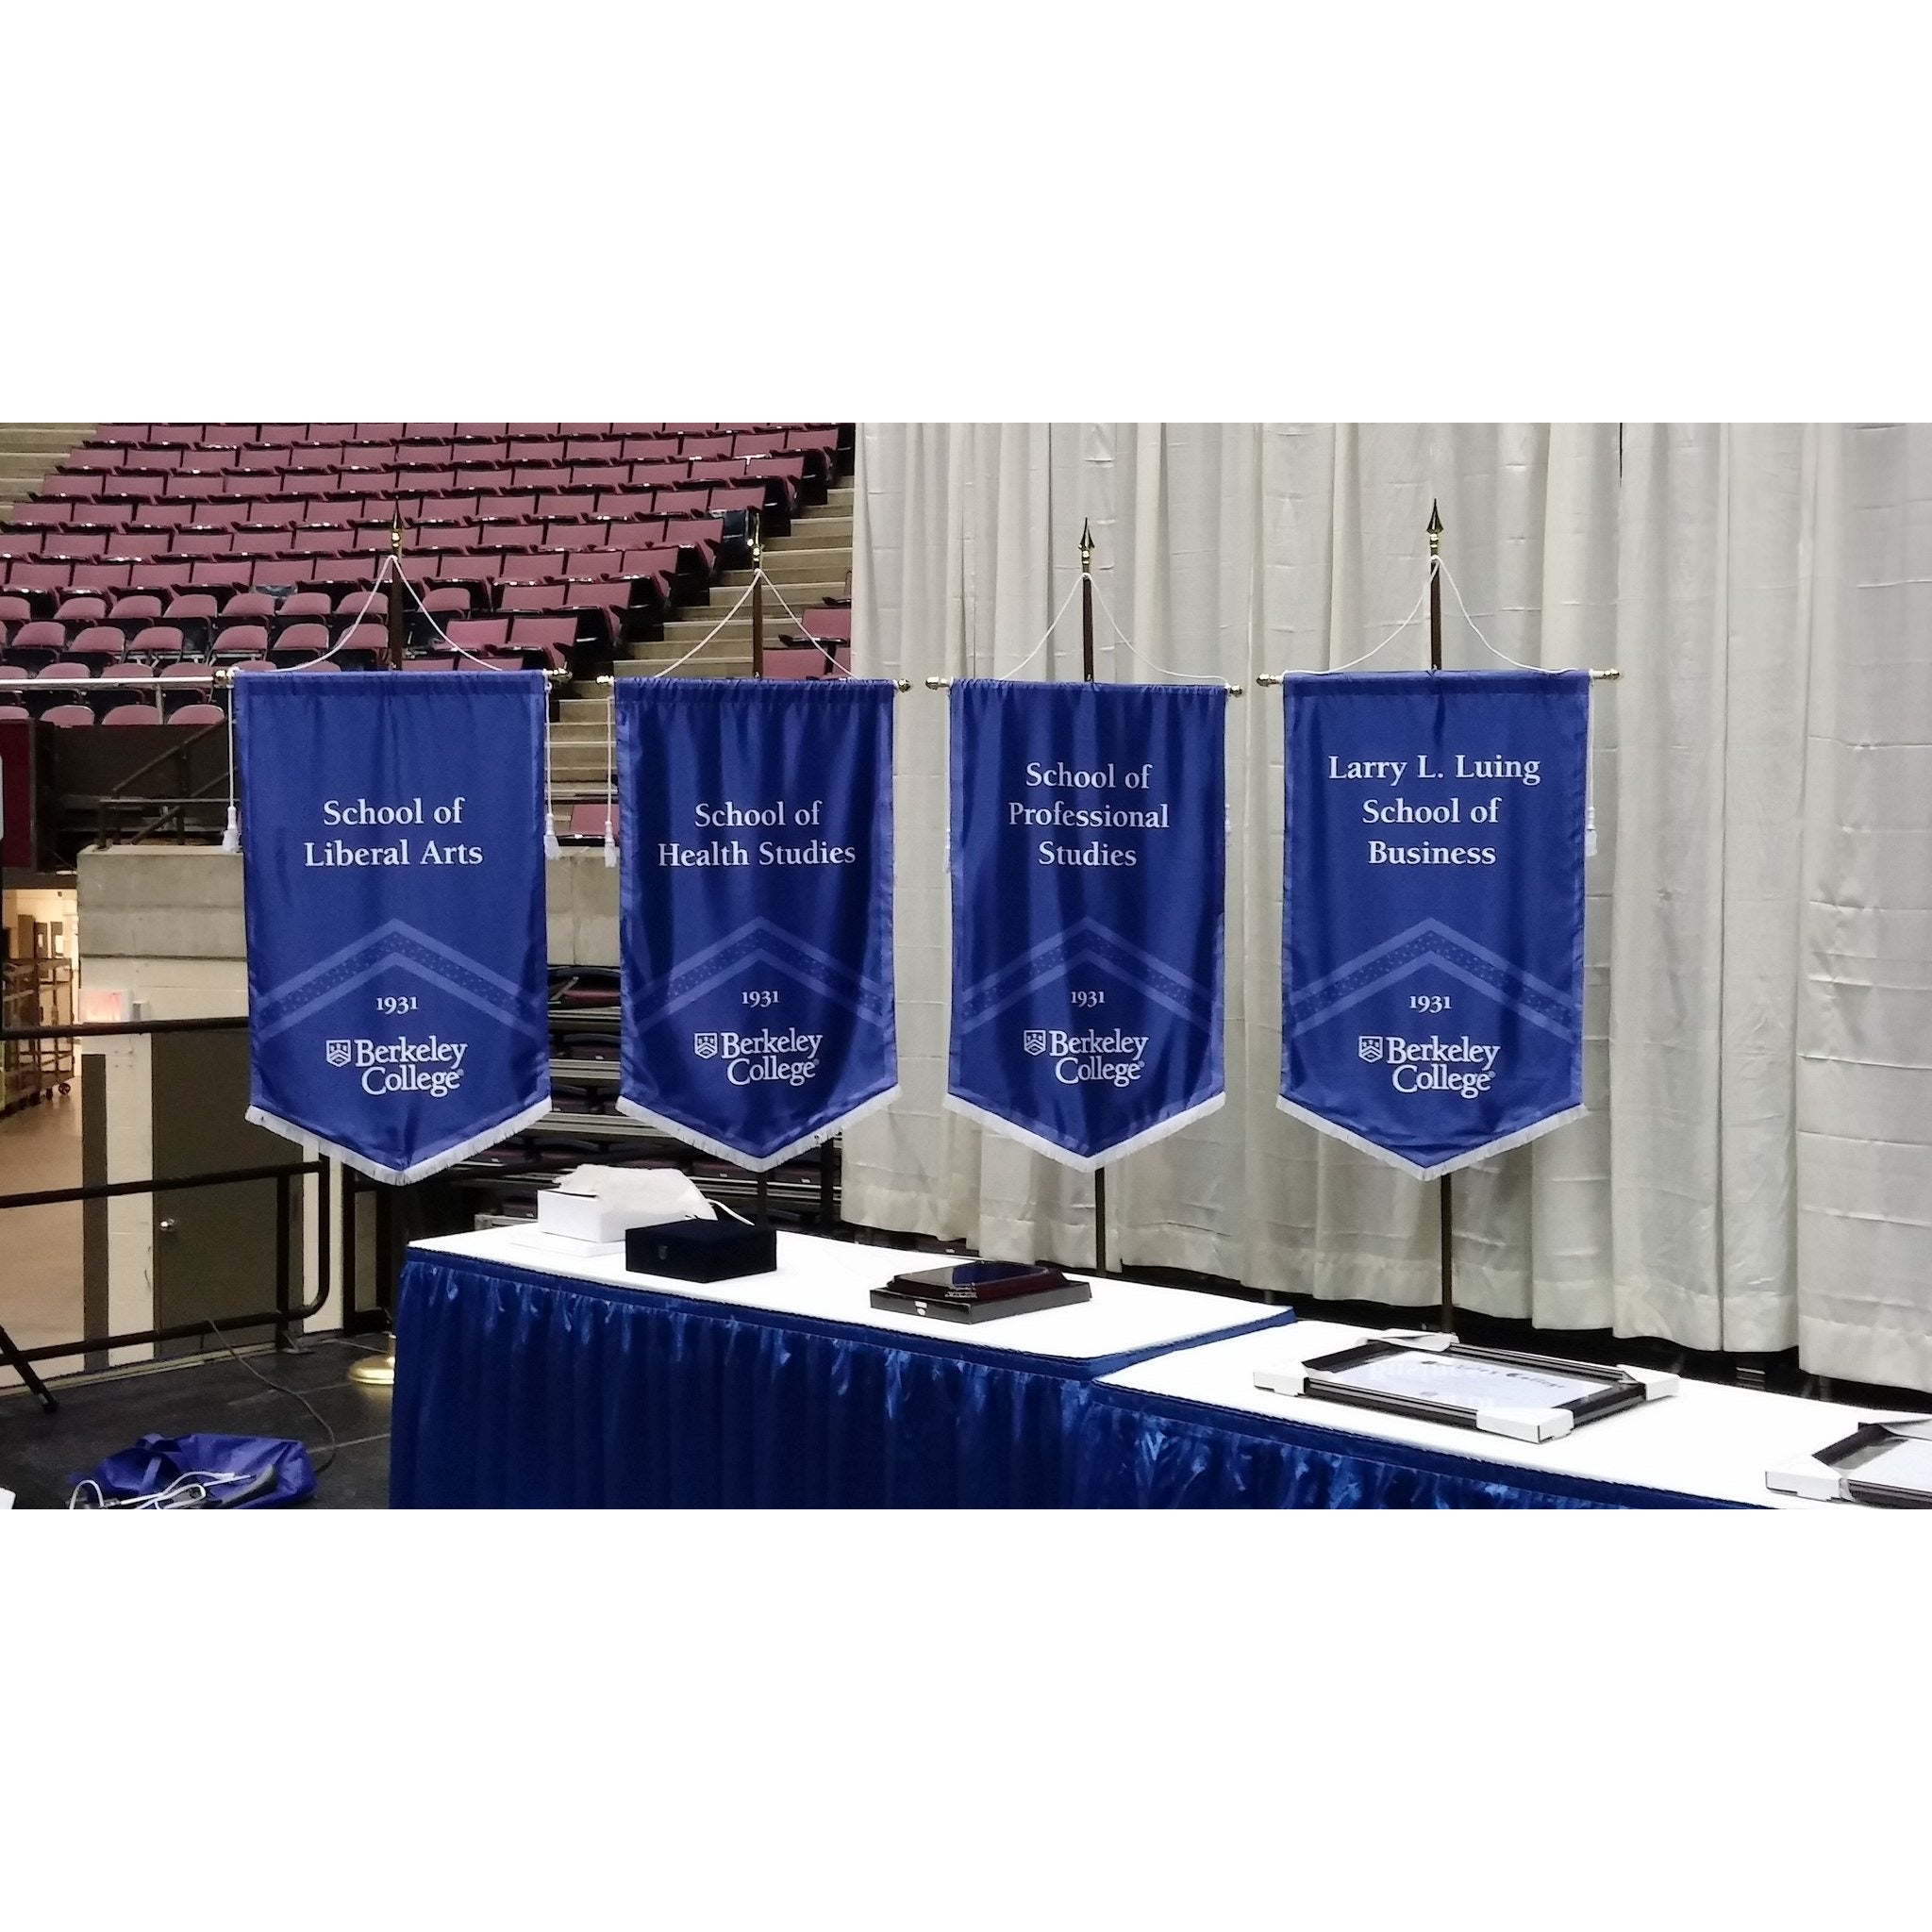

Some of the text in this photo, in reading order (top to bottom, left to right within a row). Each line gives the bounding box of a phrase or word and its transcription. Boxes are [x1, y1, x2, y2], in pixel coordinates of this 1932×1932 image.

[1024, 761, 1154, 789] School of
[1328, 754, 1542, 787] Larry L. Luing
[324, 796, 466, 825] School of
[694, 799, 823, 827] School of
[1008, 800, 1170, 828] Professional
[1362, 796, 1503, 824] School of
[304, 839, 483, 867] Liberal Arts
[658, 839, 857, 867] Health Studies
[1039, 841, 1137, 866] Studies
[1368, 840, 1496, 865] Business
[376, 995, 418, 1015] 1931
[742, 991, 780, 1008] 1931
[1071, 991, 1106, 1008] 1931
[1409, 994, 1452, 1014] 1931
[354, 1035, 468, 1070] Berkeley
[721, 1027, 824, 1059] Berkeley
[1049, 1028, 1149, 1060] Berkeley
[1386, 1035, 1501, 1071] Berkeley
[361, 1064, 460, 1098] College
[727, 1055, 817, 1087] College
[1056, 1056, 1141, 1088] College
[1392, 1063, 1491, 1099] College
